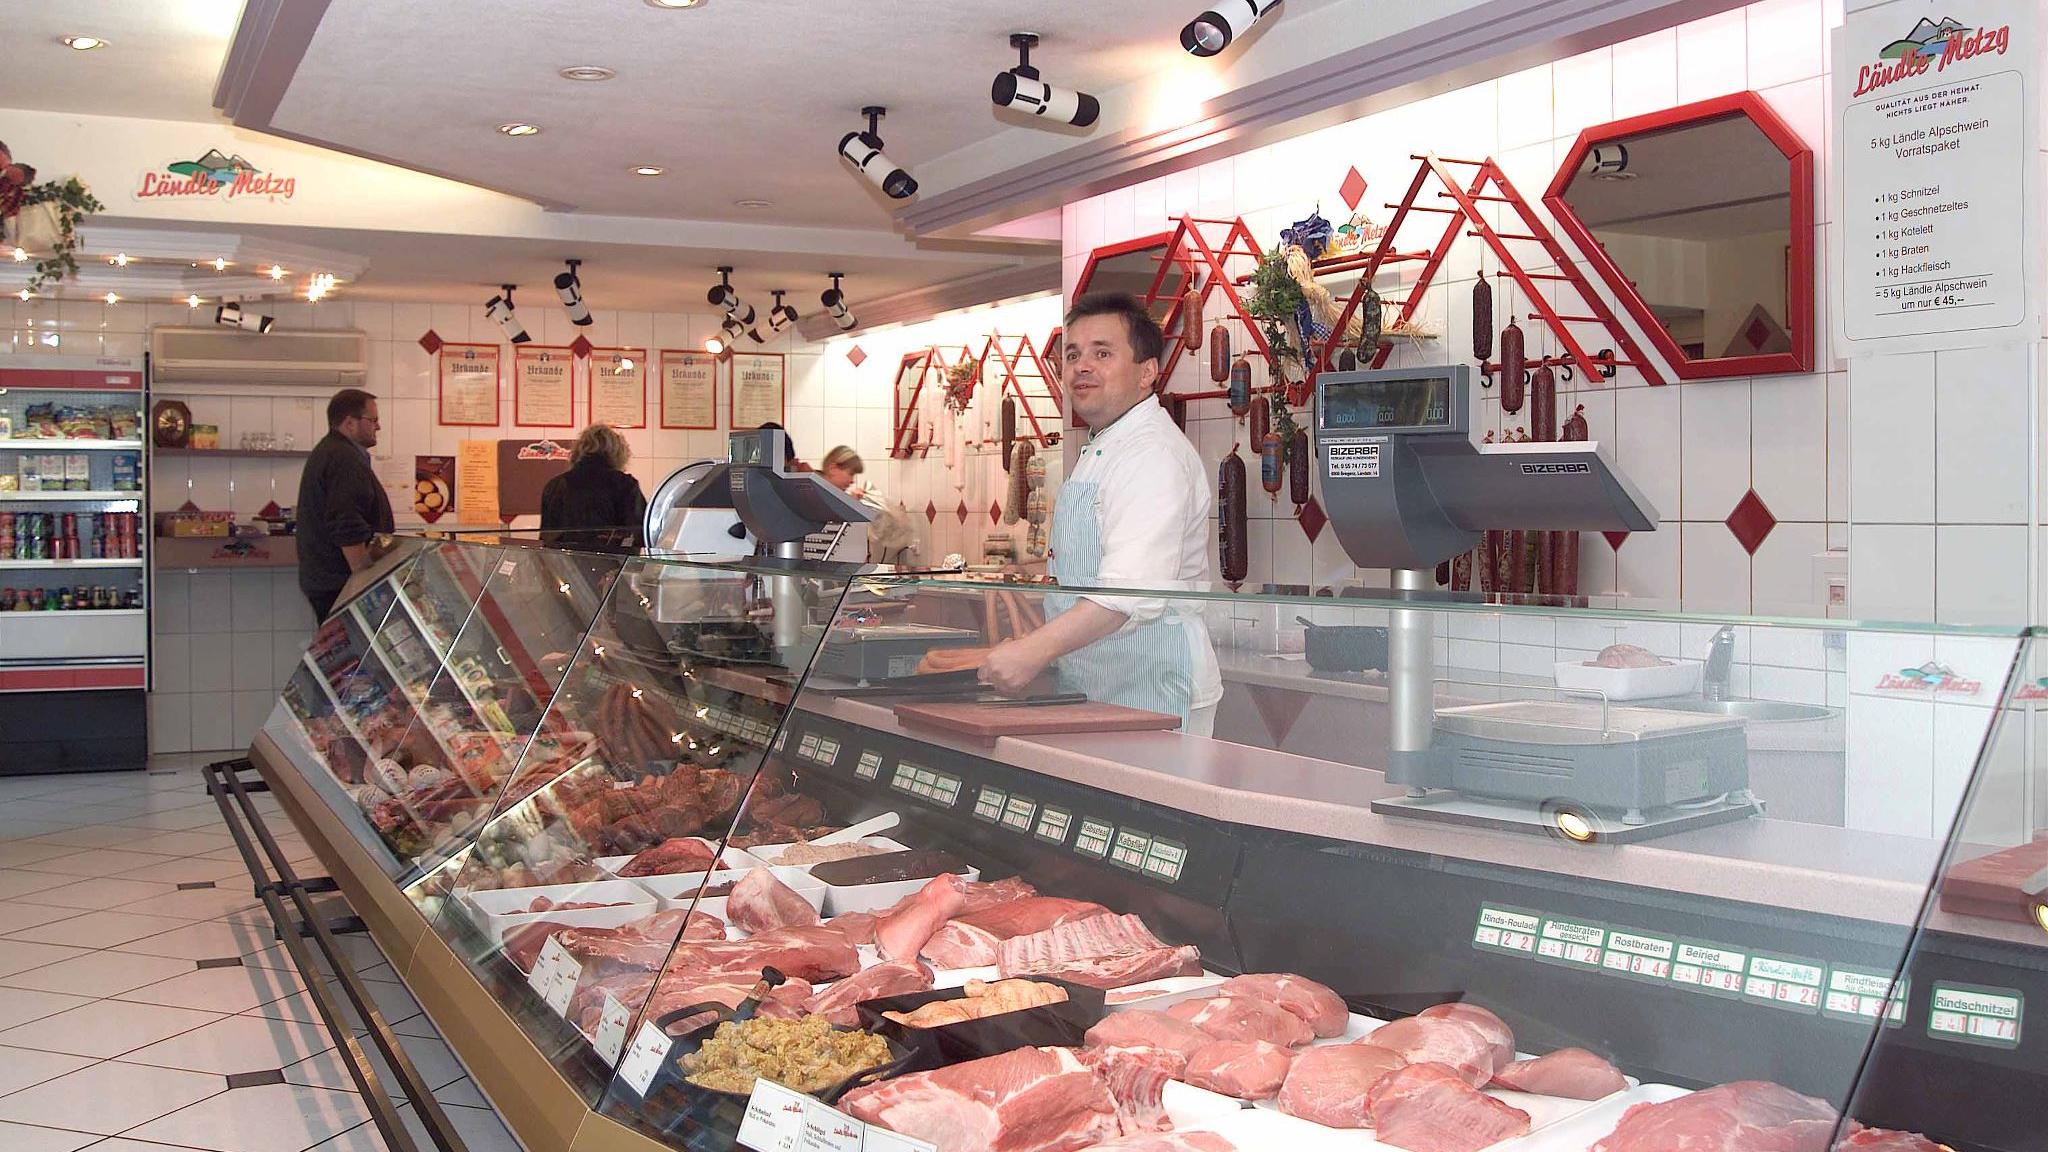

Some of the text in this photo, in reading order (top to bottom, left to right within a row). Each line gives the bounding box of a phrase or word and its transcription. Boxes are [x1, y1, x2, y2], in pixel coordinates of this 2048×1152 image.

[1853, 25, 2010, 98] Ländle Metzg
[1913, 94, 1930, 103] AUS
[1931, 90, 1949, 100] DER
[1886, 108, 1913, 119] NICHTS
[1915, 102, 1937, 113] LIEGT
[1870, 118, 1990, 150] 5 kg Ländle Alpschwein
[1896, 138, 1961, 159] Vorratspaket
[137, 168, 295, 199] Ländle Metzg
[1881, 184, 1940, 204] 1 kg Schnitzel
[1881, 200, 1969, 222] 1 kg Geschnetzeltes
[1881, 224, 1934, 241] 1 kg Kotelett
[1881, 244, 1930, 259] 1 kg Braten
[1881, 260, 1951, 278] 1 kg Hackfleisch
[1882, 288, 1889, 298] 5
[1891, 286, 1901, 300] kg
[1903, 283, 1933, 297] Ländle
[1935, 277, 1988, 294] Alpschwein
[1901, 300, 1915, 310] um
[1917, 297, 1932, 308] nur
[1934, 296, 1941, 306] €
[451, 362, 489, 373] Urkunde
[527, 365, 564, 376] Urkunde
[672, 369, 706, 379] Urkunde
[741, 370, 775, 380] Urkunde
[1330, 446, 1379, 456] BIZERBA
[1522, 463, 1590, 474] BIZERBA
[1551, 920, 1600, 937] Rindsbraten
[1614, 936, 1665, 953] Rostbraten
[1685, 946, 1720, 962] Beiried
[1935, 996, 2015, 1017] Rindschnitzel
